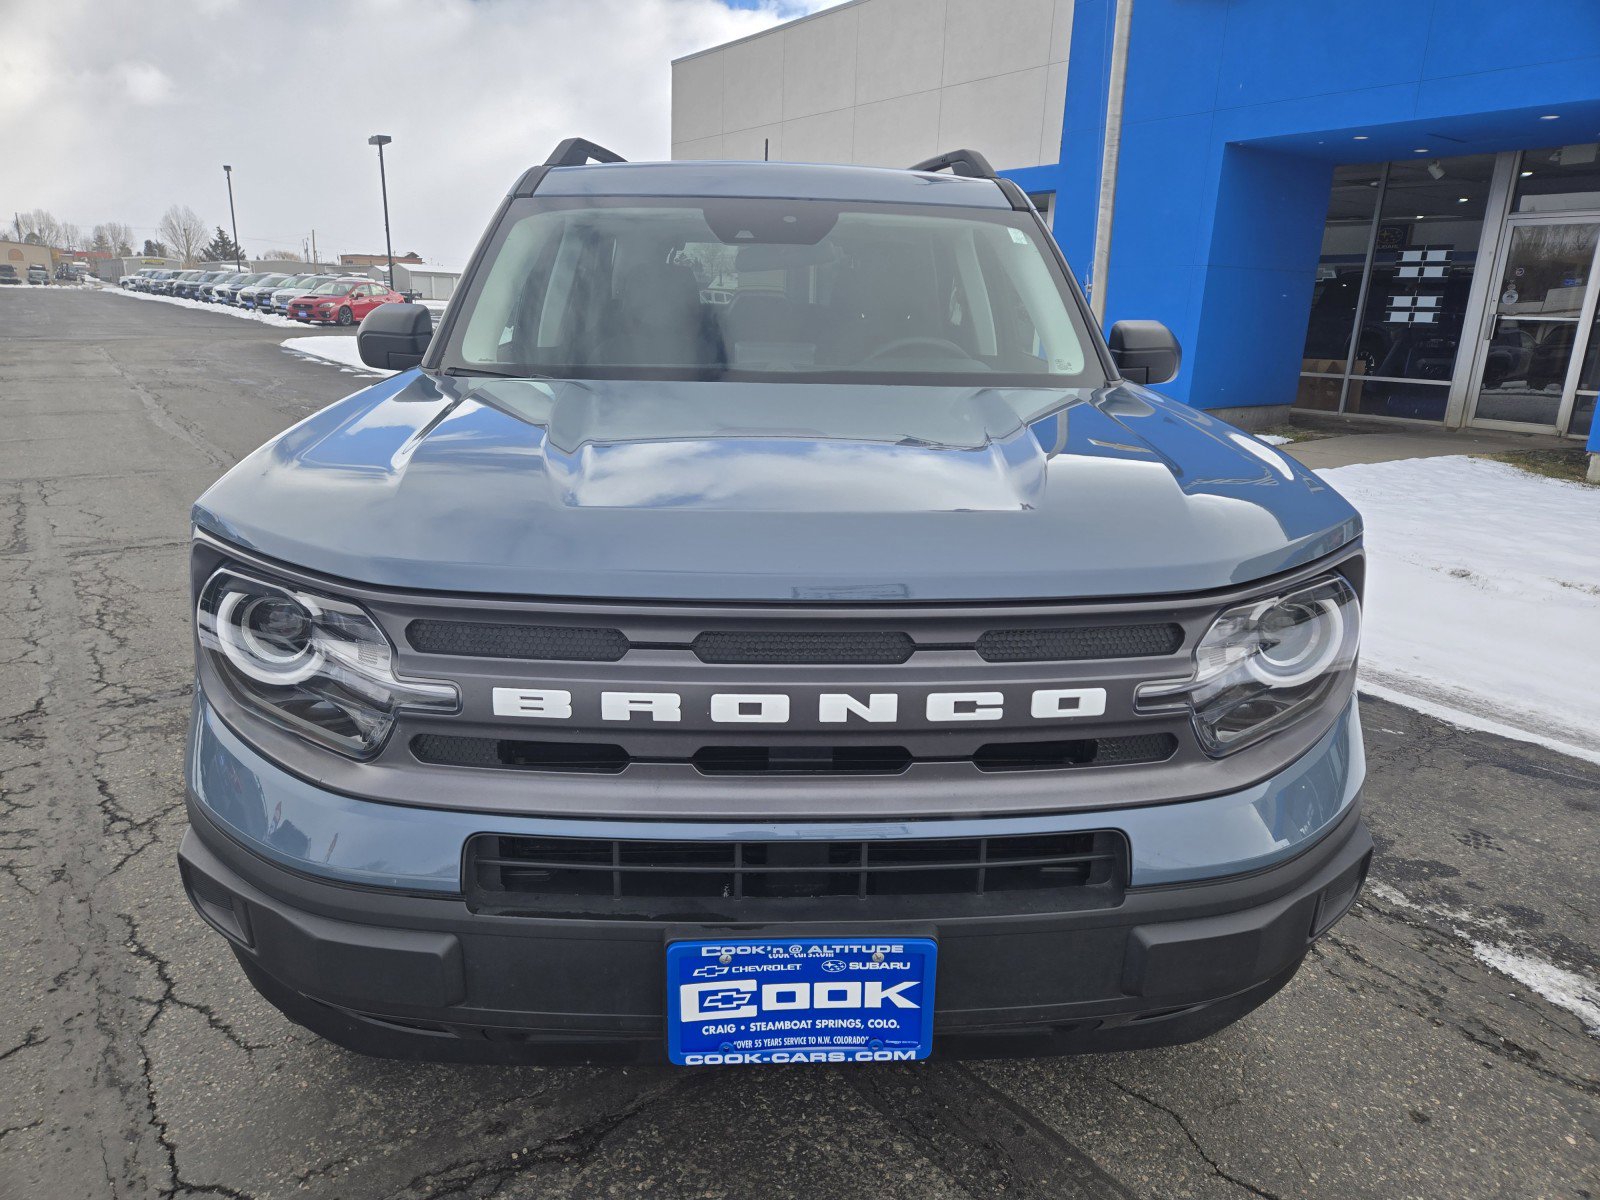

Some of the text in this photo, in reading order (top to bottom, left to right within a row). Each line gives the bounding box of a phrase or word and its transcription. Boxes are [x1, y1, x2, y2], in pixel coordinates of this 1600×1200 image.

[493, 687, 1107, 723] BRONCO
[808, 945, 903, 954] ALTITUDE
[732, 963, 802, 973] CHEVROLET
[849, 962, 910, 970] SUBARU
[680, 979, 921, 1022] COOK
[702, 1019, 900, 1035] CRAIG STEAMBOAT SPRINGS, COLO.
[755, 1039, 762, 1047] 55
[763, 1038, 782, 1047] YEARS
[783, 1037, 807, 1046] SERVICE
[808, 1037, 816, 1045] TO
[818, 1036, 832, 1044] N.W.
[685, 1051, 916, 1065] COOK-CARS.COM
